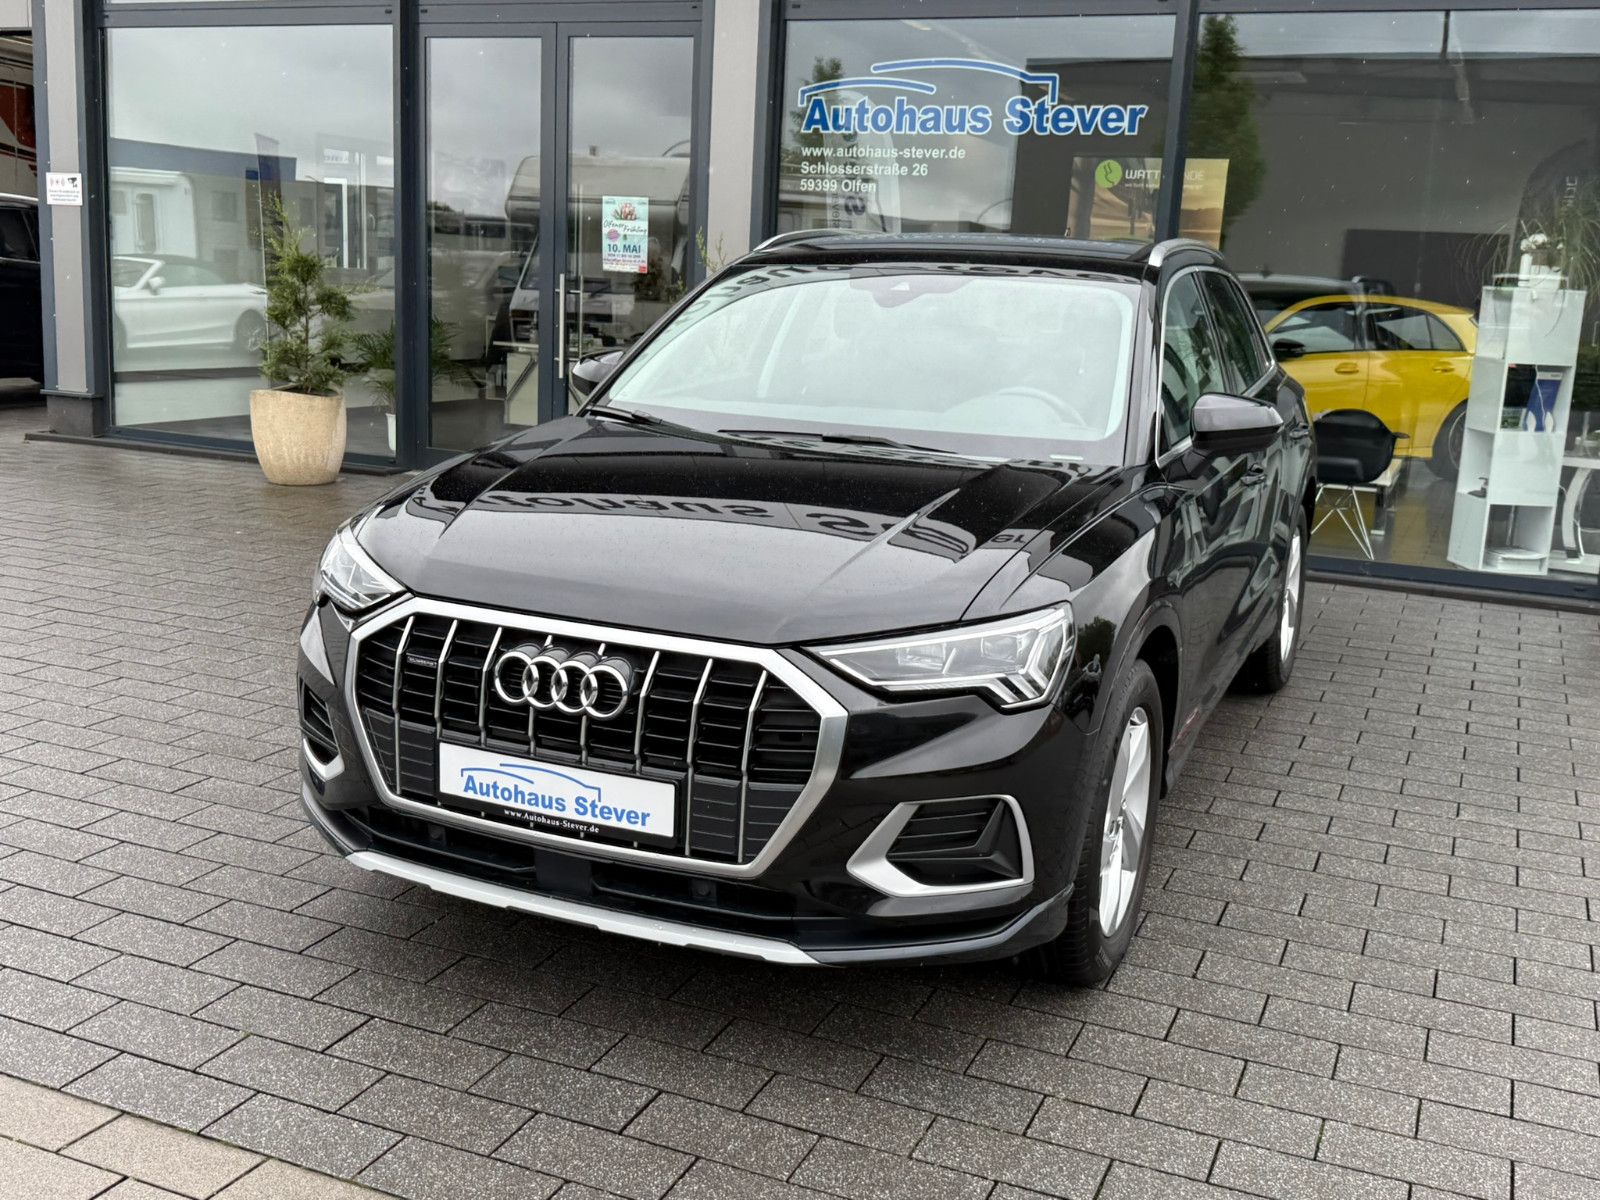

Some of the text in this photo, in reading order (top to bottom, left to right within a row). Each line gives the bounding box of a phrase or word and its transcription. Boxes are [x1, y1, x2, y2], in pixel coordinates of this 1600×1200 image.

[801, 96, 1148, 136] Autohaus Stever
[801, 146, 966, 159] www.autohaus-stever.de
[800, 162, 928, 176] Schlosserstraße 26
[800, 179, 876, 193] 59399 Olfen
[607, 243, 641, 254] 10. MAI
[463, 775, 651, 827] Autohaus Stever
[503, 808, 600, 834] www.Autohaus-Stever.de
